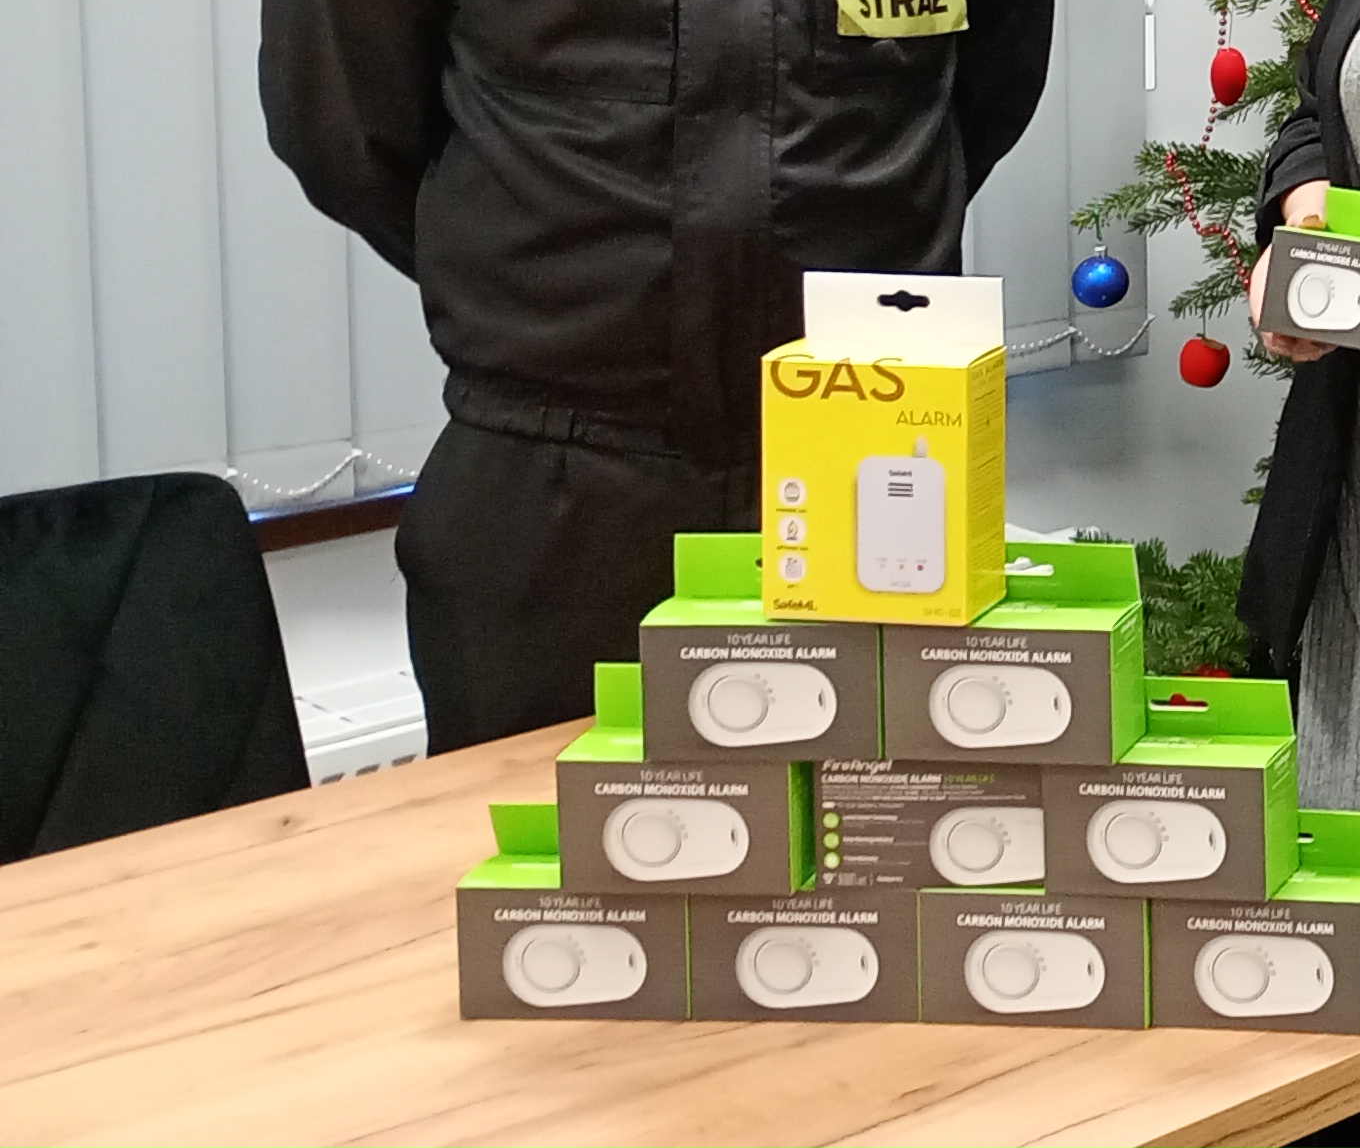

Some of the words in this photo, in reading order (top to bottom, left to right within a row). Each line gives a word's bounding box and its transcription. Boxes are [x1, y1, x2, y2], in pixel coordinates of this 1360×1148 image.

[770, 354, 906, 403] GAS
[895, 410, 962, 427] ALARM
[680, 646, 729, 660] CARBON
[730, 647, 794, 660] MONOXIDE
[795, 647, 837, 660] ALARM
[921, 647, 968, 661] CARBON
[969, 649, 1030, 663] MONOXIDE
[1031, 651, 1072, 664] ALARM
[594, 782, 642, 796] CARBON
[643, 783, 706, 797] MONOXIDE
[707, 783, 749, 797] ALARM
[1079, 782, 1125, 796] CARBON
[1126, 785, 1185, 799] MONOXIDE
[1186, 786, 1226, 800] ALARM
[494, 908, 541, 922] CARBON
[542, 909, 604, 922] MONOXIDE
[605, 909, 646, 923] ALARM
[727, 910, 774, 924] CARBON
[775, 911, 837, 924] MONOXIDE
[838, 910, 879, 924] ALARM
[956, 913, 1002, 928] CARBON
[1003, 915, 1065, 929] MONOXIDE
[1065, 916, 1106, 930] ALARM
[1187, 916, 1232, 932] CARBON
[1234, 919, 1294, 933] MONOXIDE
[1295, 921, 1335, 935] ALARM
